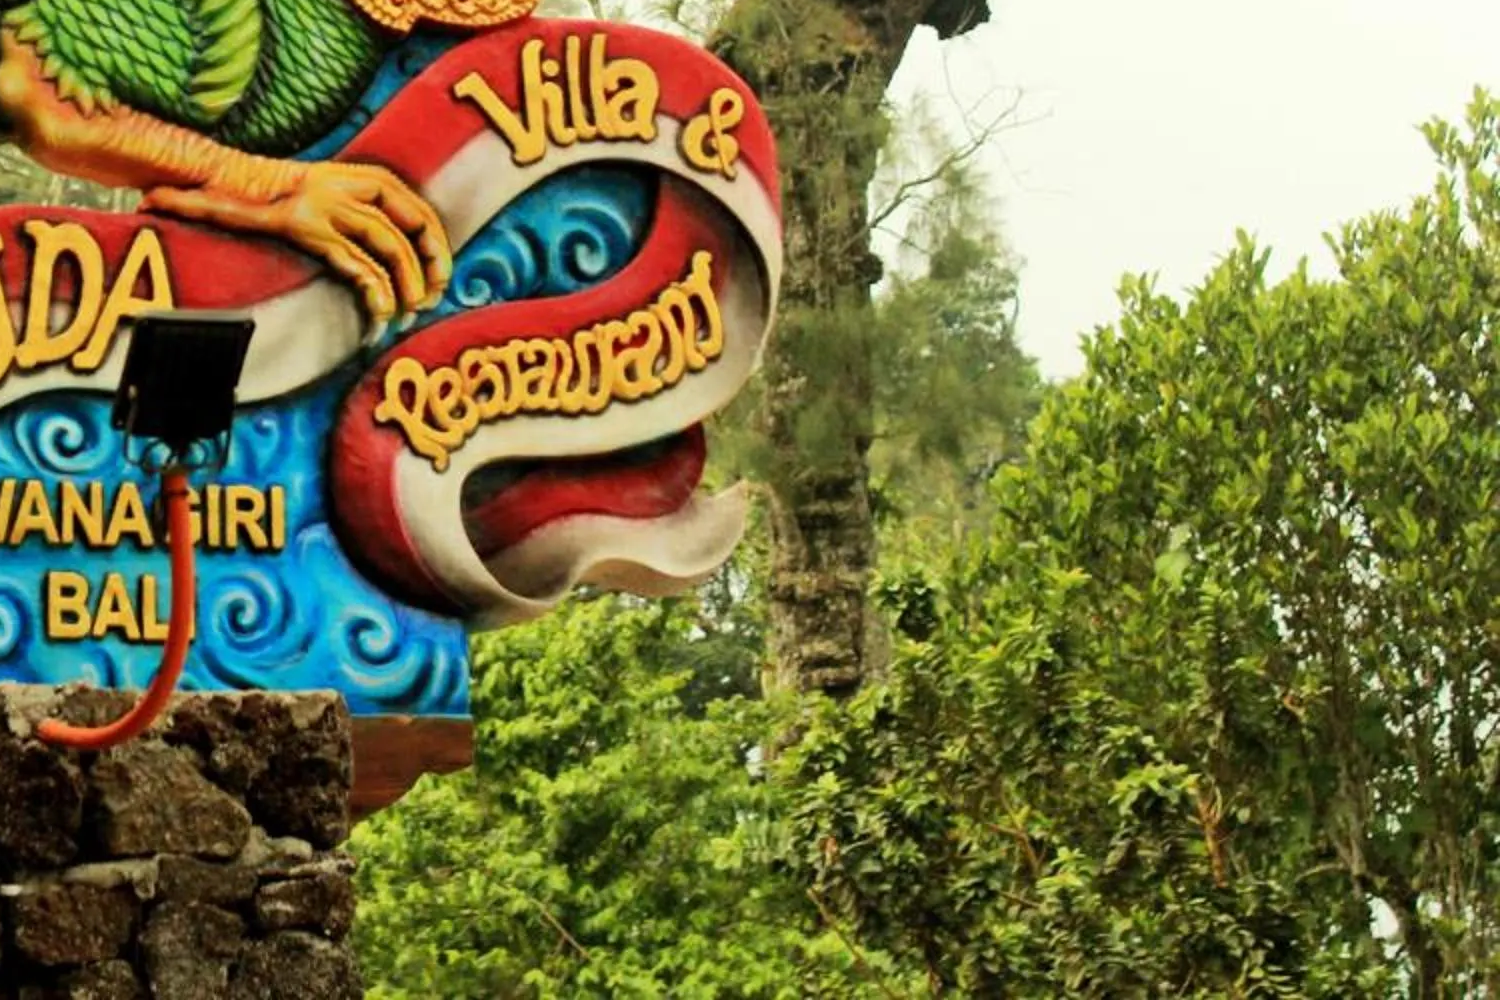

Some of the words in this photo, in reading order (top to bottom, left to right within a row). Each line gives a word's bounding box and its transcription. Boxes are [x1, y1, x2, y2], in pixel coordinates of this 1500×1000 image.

[453, 33, 659, 165] Villa
[680, 87, 744, 180] &
[374, 250, 723, 472] Restaurant
[47, 571, 195, 640] BAL
